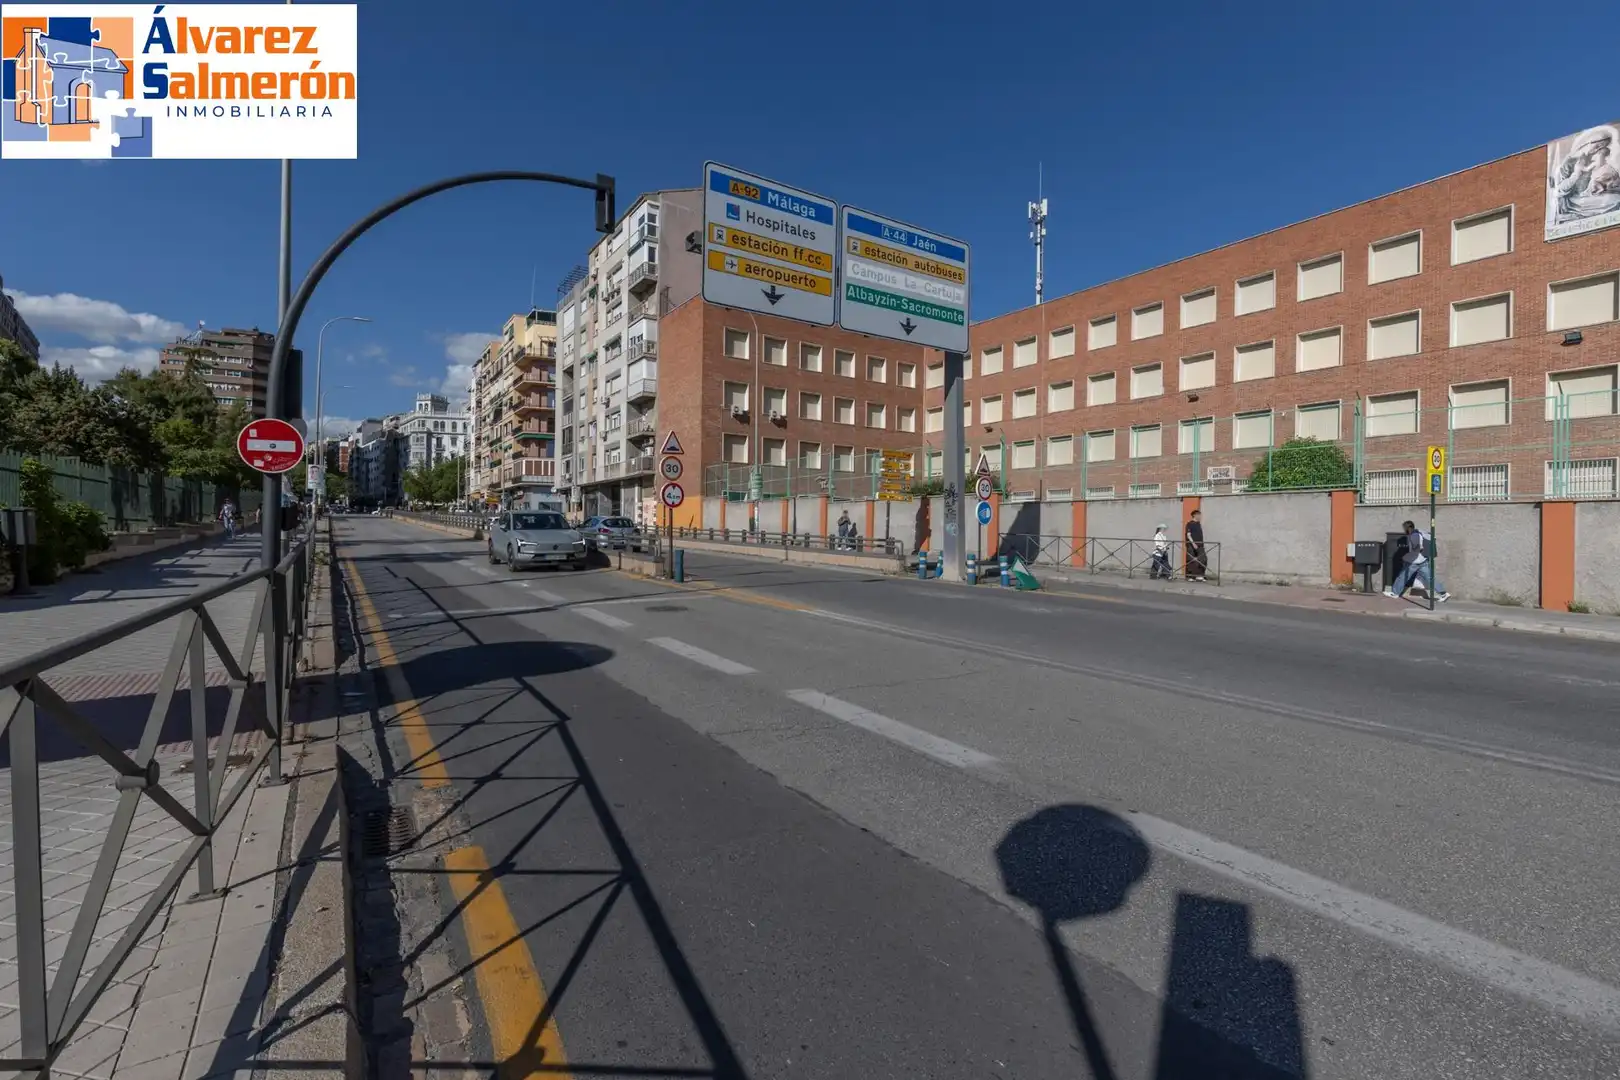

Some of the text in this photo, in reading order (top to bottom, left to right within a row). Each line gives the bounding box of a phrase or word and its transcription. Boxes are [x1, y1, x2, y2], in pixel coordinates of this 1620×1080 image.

[731, 182, 816, 218] A-92 Málaga
[746, 210, 816, 241] Hospitales
[883, 227, 937, 252] A-44 Jaén
[731, 234, 825, 267] estación ff.cc.
[864, 245, 963, 281] estación autobuses
[744, 262, 816, 289] aeropuerto
[852, 263, 962, 303] Campus La Cartuja
[665, 464, 679, 474] 30
[981, 483, 990, 493] 30
